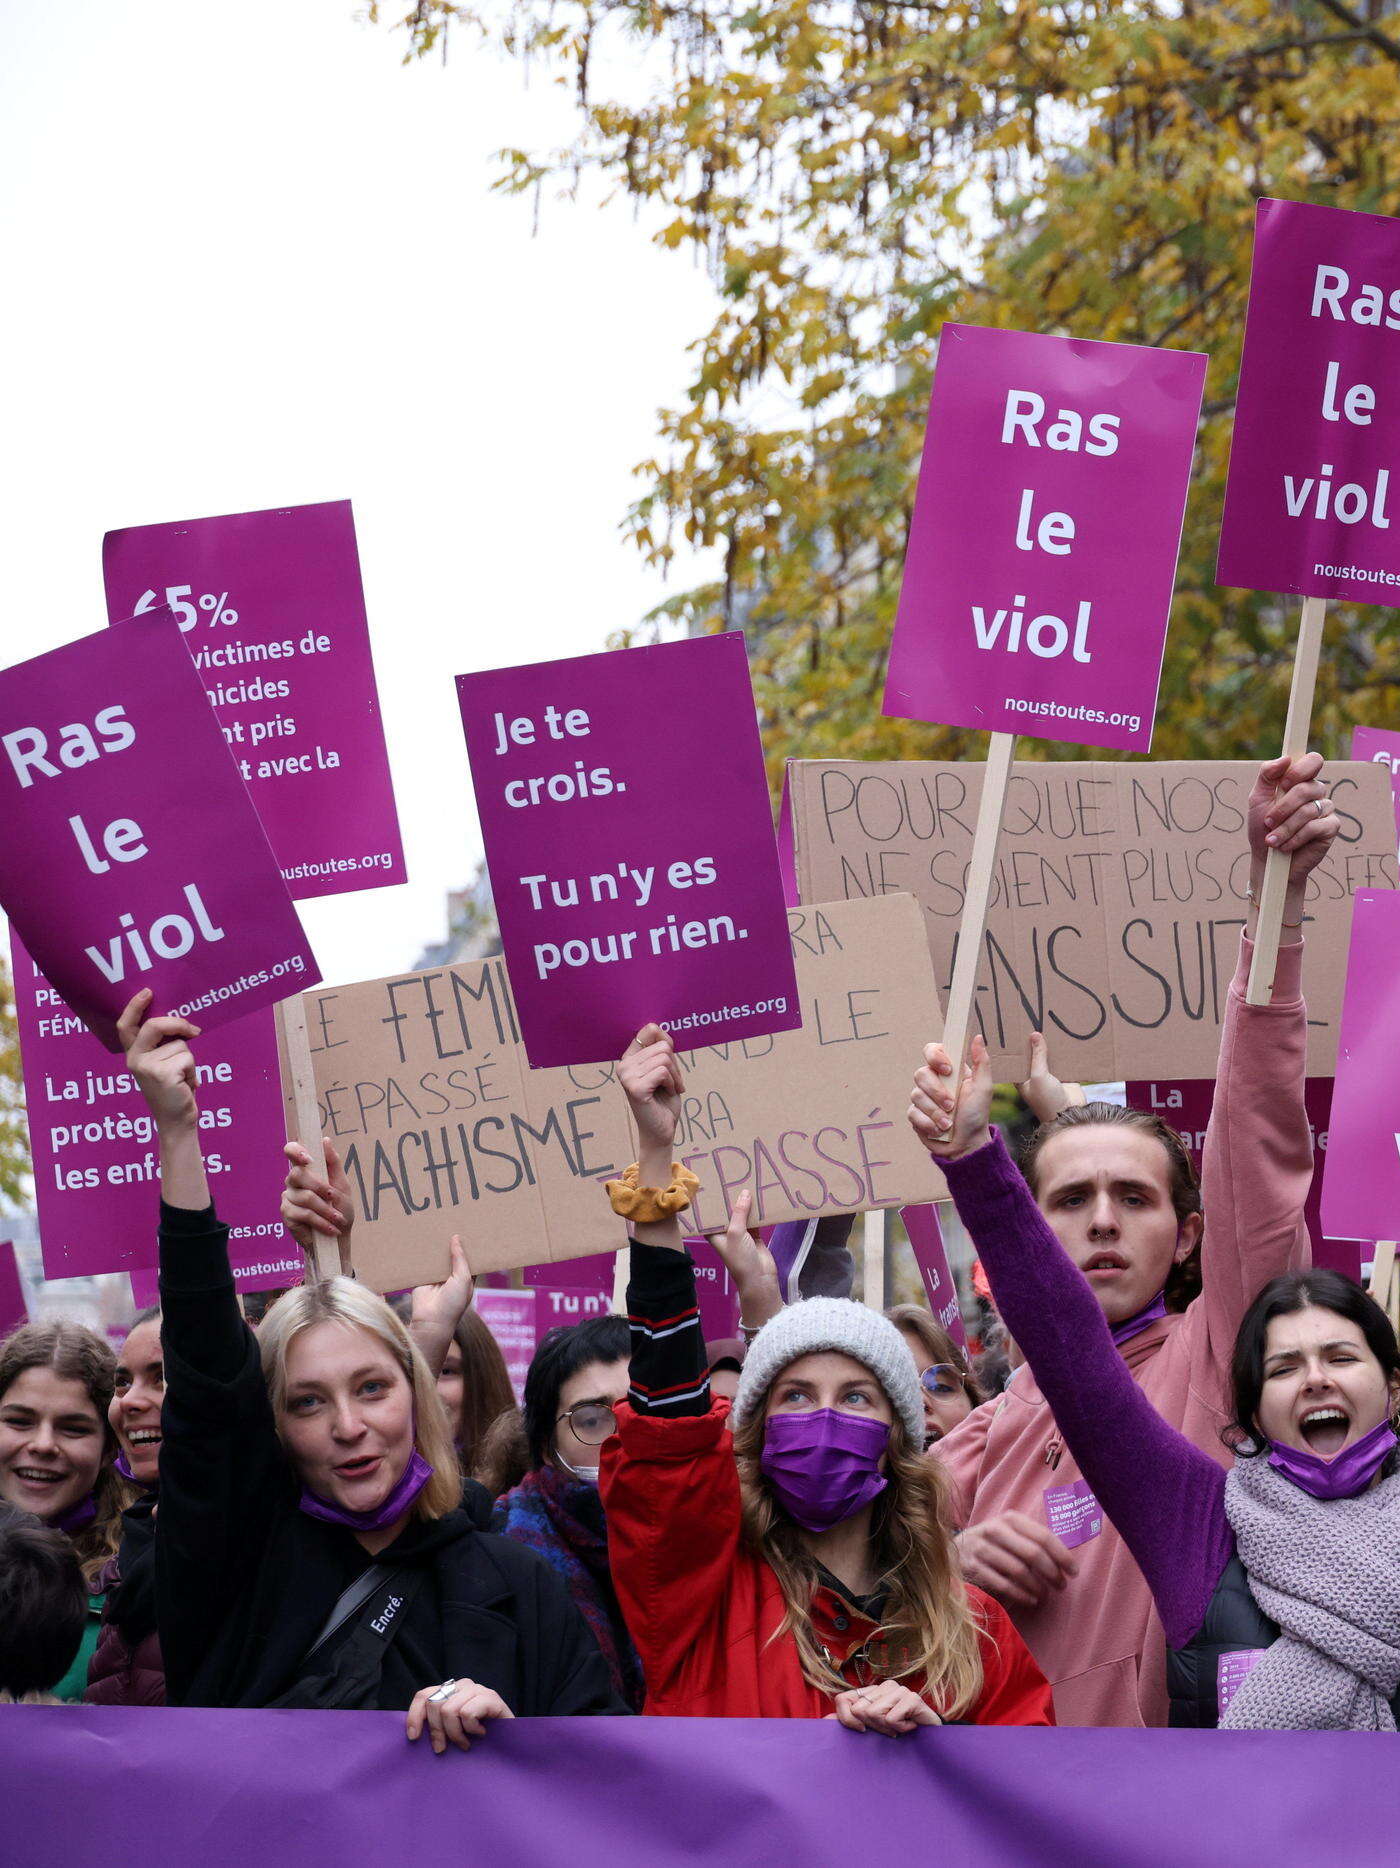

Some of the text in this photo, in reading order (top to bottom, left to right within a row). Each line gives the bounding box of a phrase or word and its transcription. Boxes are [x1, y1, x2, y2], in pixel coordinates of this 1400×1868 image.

[1321, 362, 1376, 426] le
[1001, 390, 1121, 457] Ras
[1283, 464, 1390, 529] viol
[1015, 489, 1076, 556] le
[192, 630, 332, 670] victimes de
[971, 595, 1092, 664] viol
[206, 676, 290, 707] nicides
[1004, 698, 1141, 733] noustoutes.org
[1, 705, 137, 789] Ras
[250, 714, 297, 746] pris
[494, 705, 591, 755] Je te
[257, 754, 313, 779] avec
[315, 746, 341, 771] la
[504, 761, 627, 809] crois.
[821, 770, 974, 844] POUR
[1132, 777, 1245, 837] NOS
[69, 815, 149, 876] le
[519, 855, 718, 911] Tu n'y es
[1123, 848, 1222, 908] PLUS
[85, 883, 226, 985] viol
[532, 914, 749, 981] pour rien.
[659, 995, 787, 1034] oustoutes.org
[814, 989, 889, 1046] LE
[45, 1075, 80, 1103] La
[195, 1061, 233, 1085] ne
[1150, 1083, 1183, 1109] La
[50, 1106, 233, 1154] protèg as
[54, 1163, 101, 1191] les
[549, 1292, 579, 1313] Tu
[370, 1595, 404, 1634] Encré.
